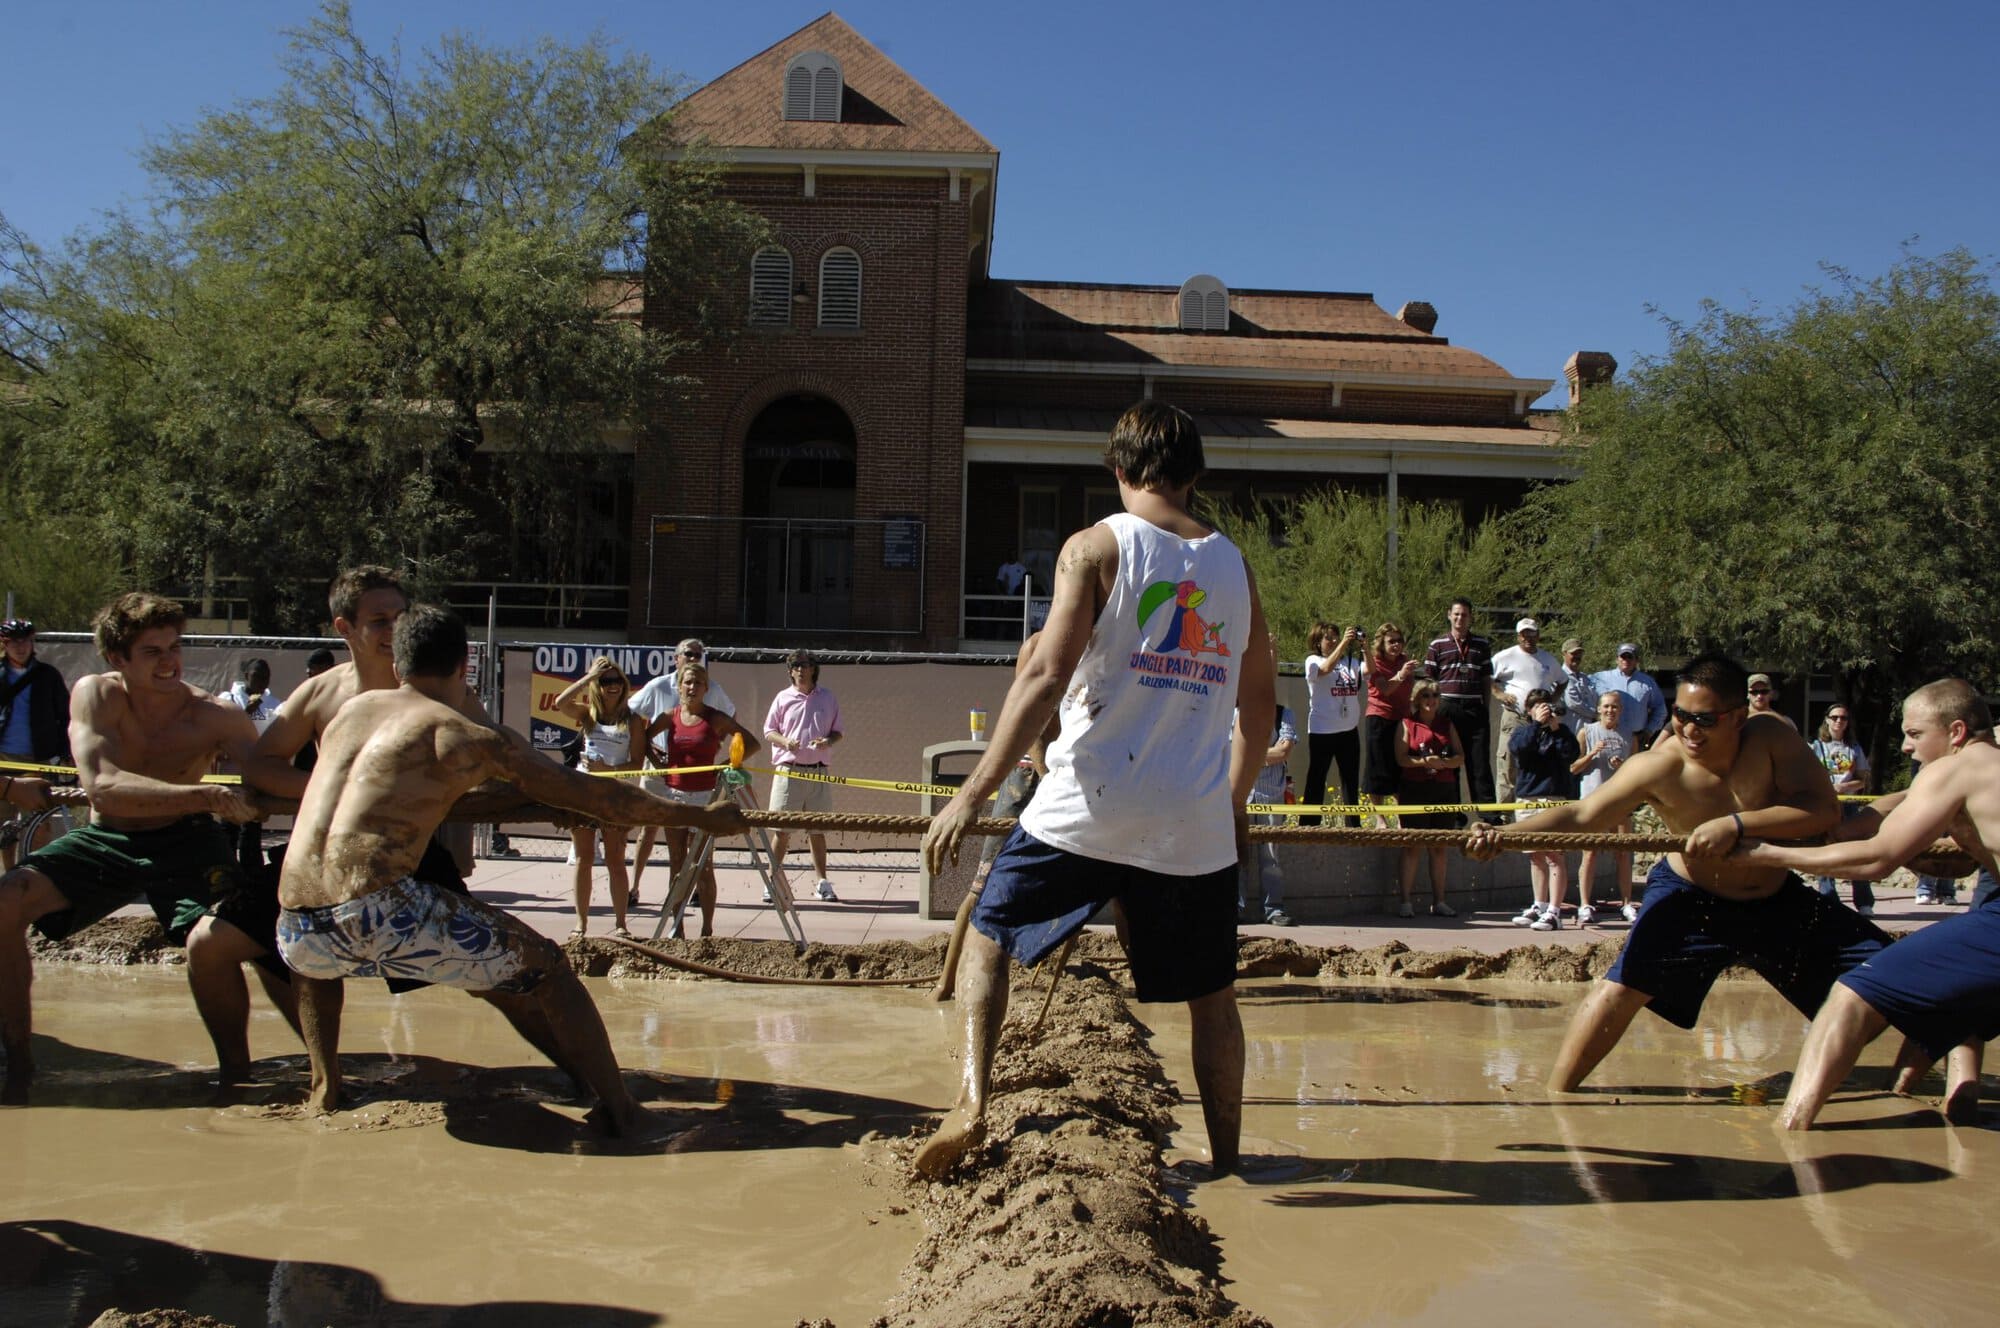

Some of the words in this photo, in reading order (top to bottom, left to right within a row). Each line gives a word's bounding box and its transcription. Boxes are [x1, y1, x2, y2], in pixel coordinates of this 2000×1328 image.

[758, 447, 791, 458] OLD
[801, 447, 841, 458] MAIN
[535, 646, 578, 673] OLD
[1166, 656, 1201, 679] PARTY
[1137, 675, 1179, 691] ARIZONA
[1180, 680, 1209, 696] ALPHA
[895, 783, 954, 795] CAUTION
[1423, 805, 1480, 813] CAUTION
